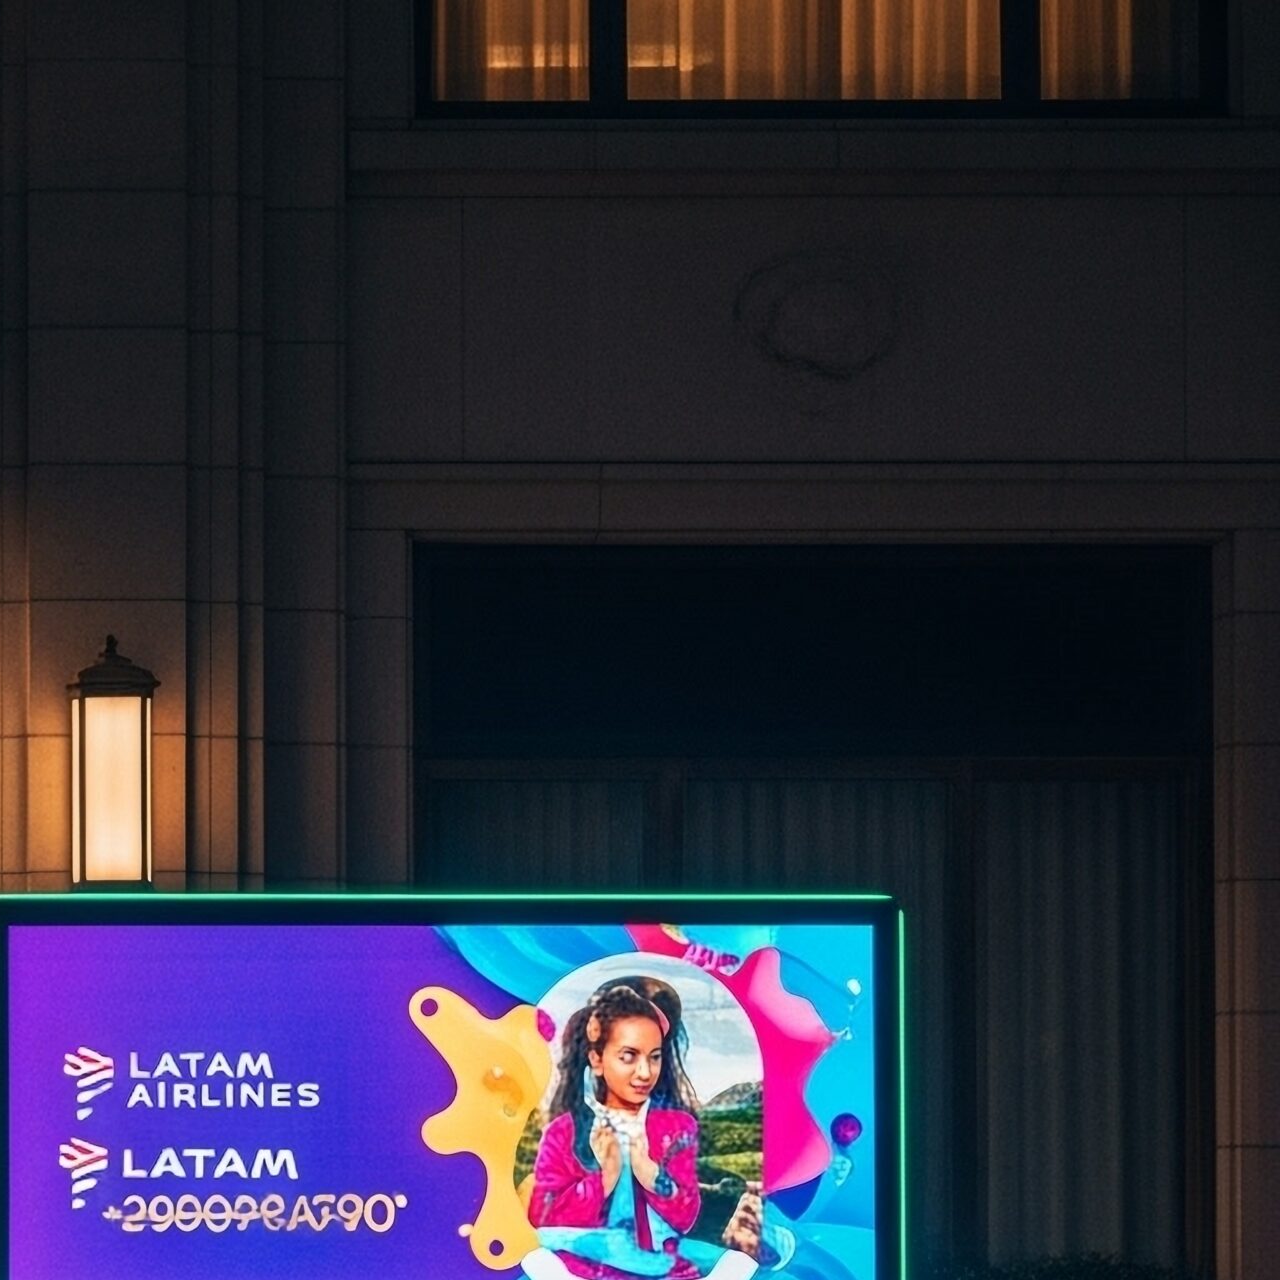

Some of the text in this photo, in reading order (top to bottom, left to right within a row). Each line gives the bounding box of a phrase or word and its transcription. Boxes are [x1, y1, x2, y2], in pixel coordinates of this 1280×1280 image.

[129, 1051, 274, 1079] LATAM
[126, 1081, 320, 1109] AIRLINES
[122, 1147, 299, 1180] LATAM
